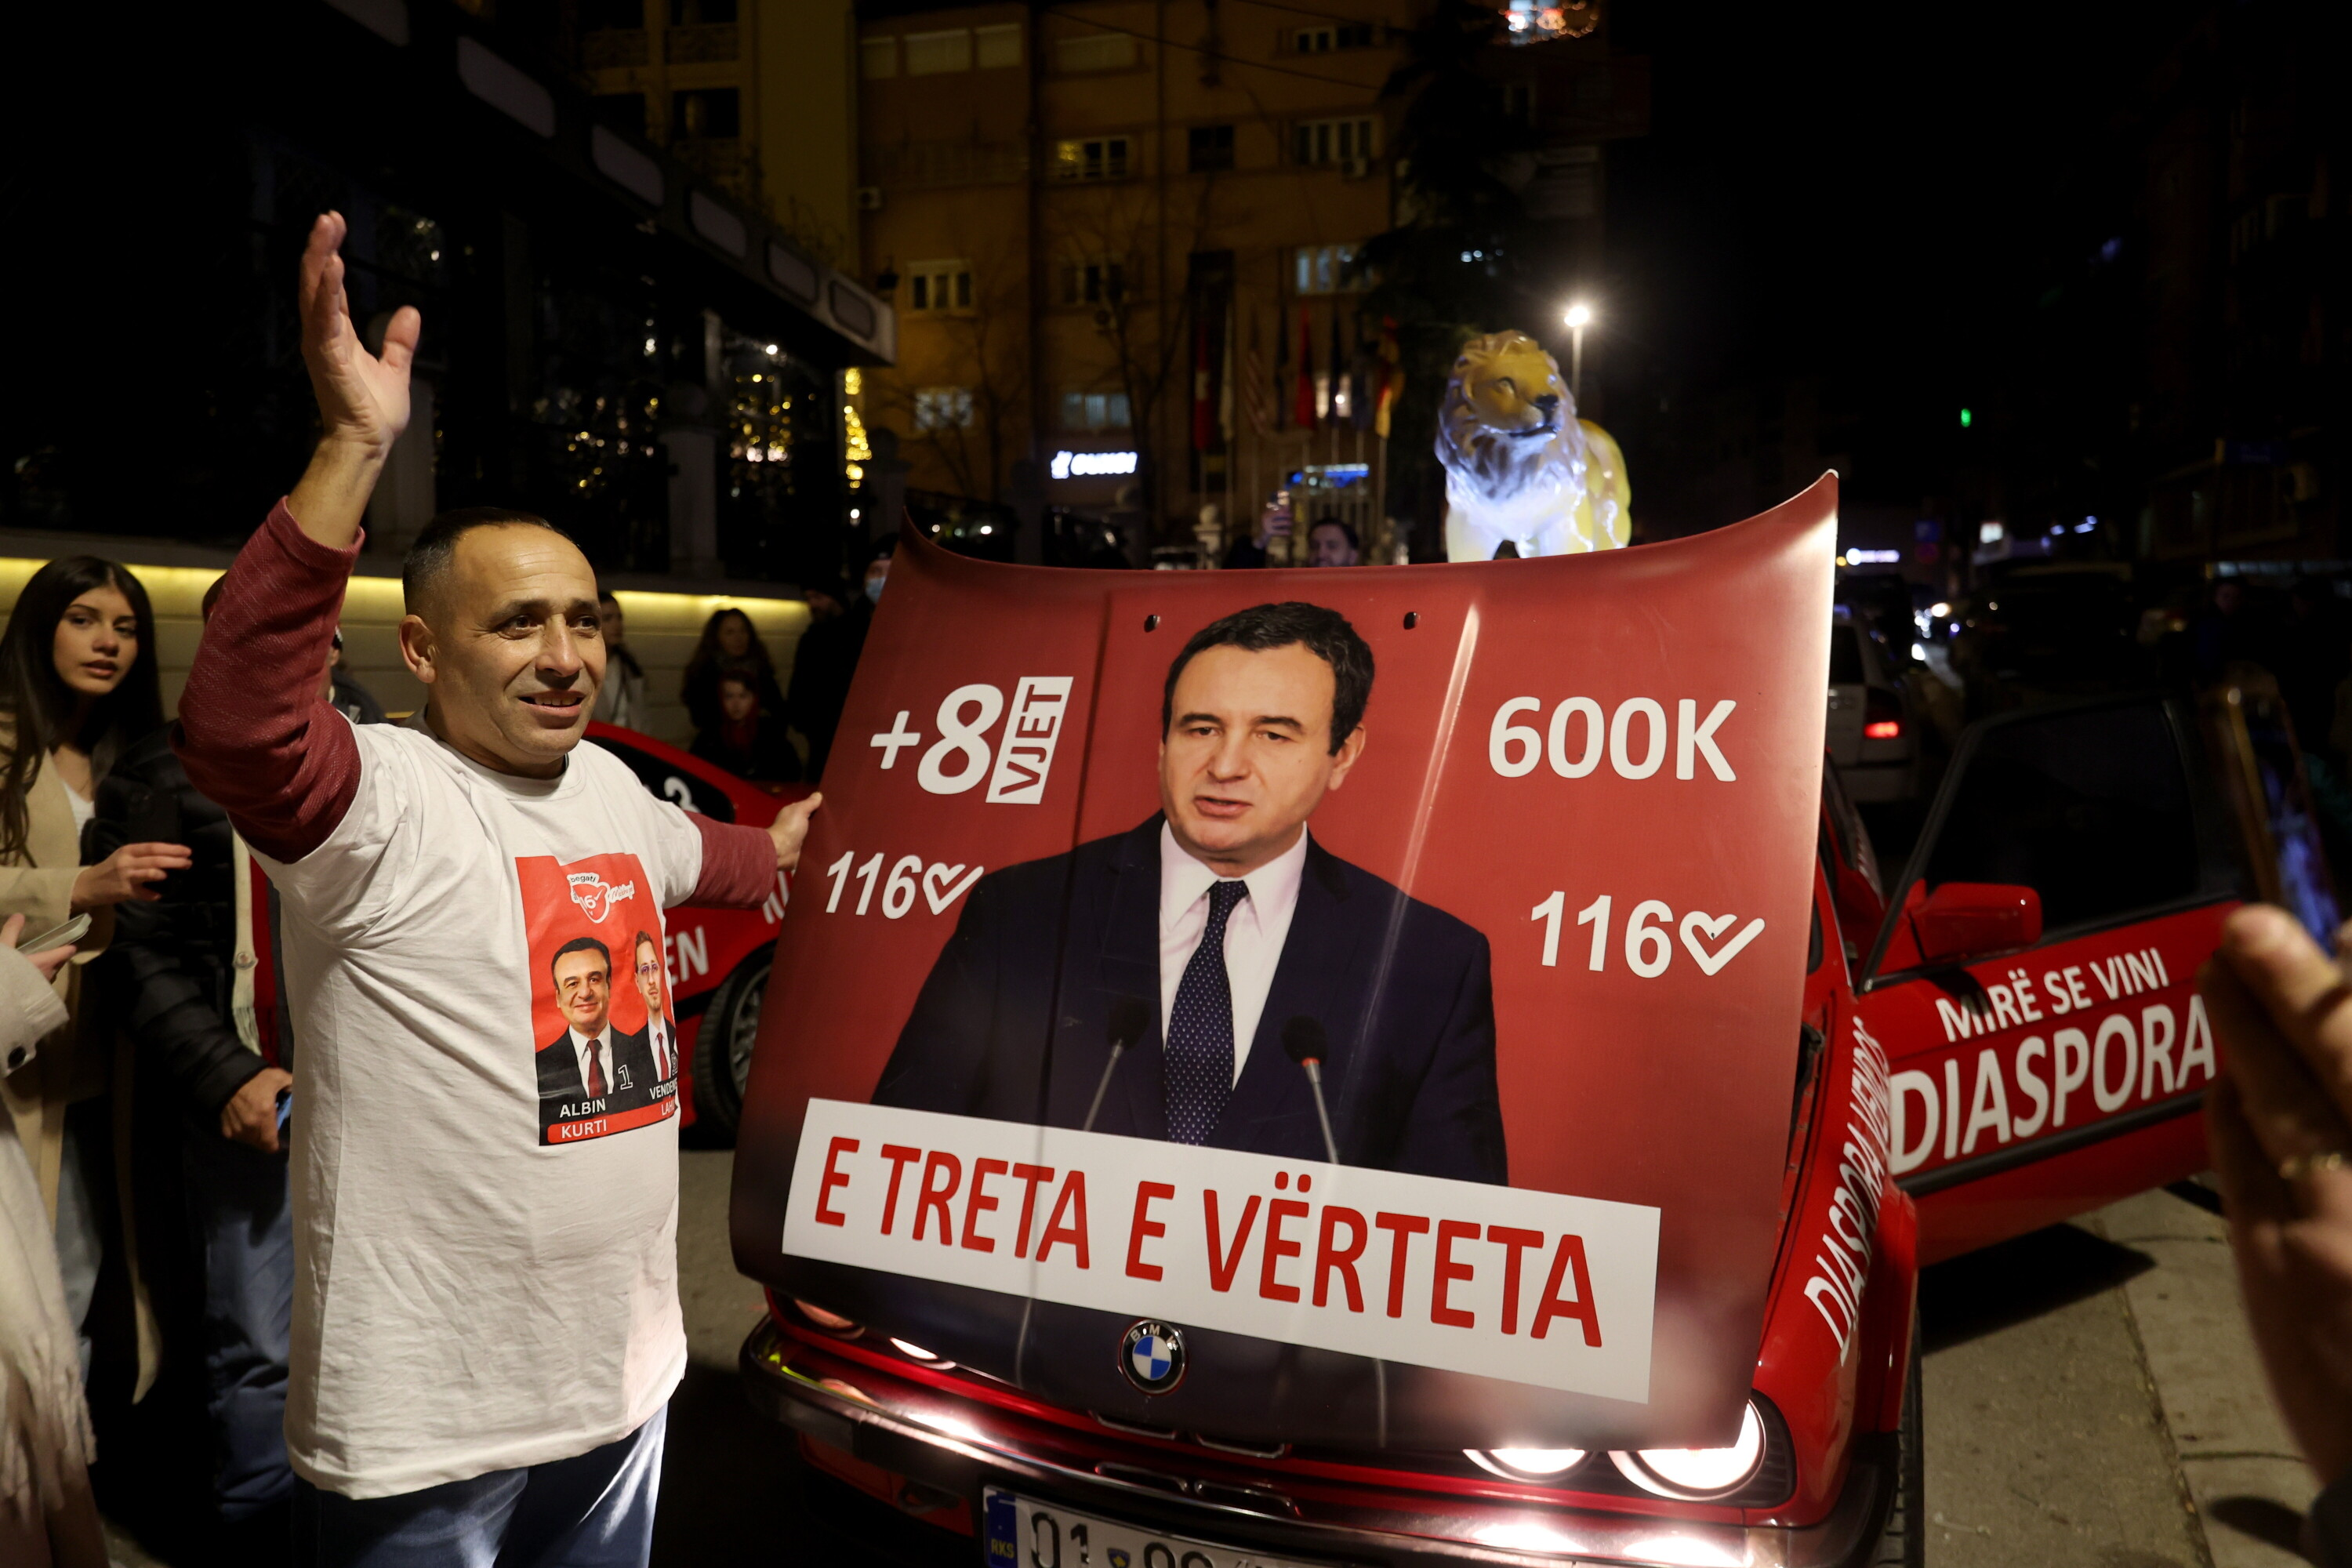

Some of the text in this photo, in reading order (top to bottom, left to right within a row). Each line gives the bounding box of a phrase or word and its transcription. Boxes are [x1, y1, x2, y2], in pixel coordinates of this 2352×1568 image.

[870, 684, 1004, 794] +8
[998, 684, 1062, 797] VJET
[1489, 696, 1737, 782] 600K
[826, 851, 922, 919] 116
[1531, 891, 1674, 978] 116
[1935, 947, 2170, 1043] MIRË SE VINI
[559, 1098, 606, 1118] ALBIN
[1889, 994, 2216, 1176] DIASPORA
[561, 1119, 607, 1139] KURTI
[815, 1136, 1602, 1348] E TRETA E VËRTETA
[990, 1537, 1014, 1559] RKS
